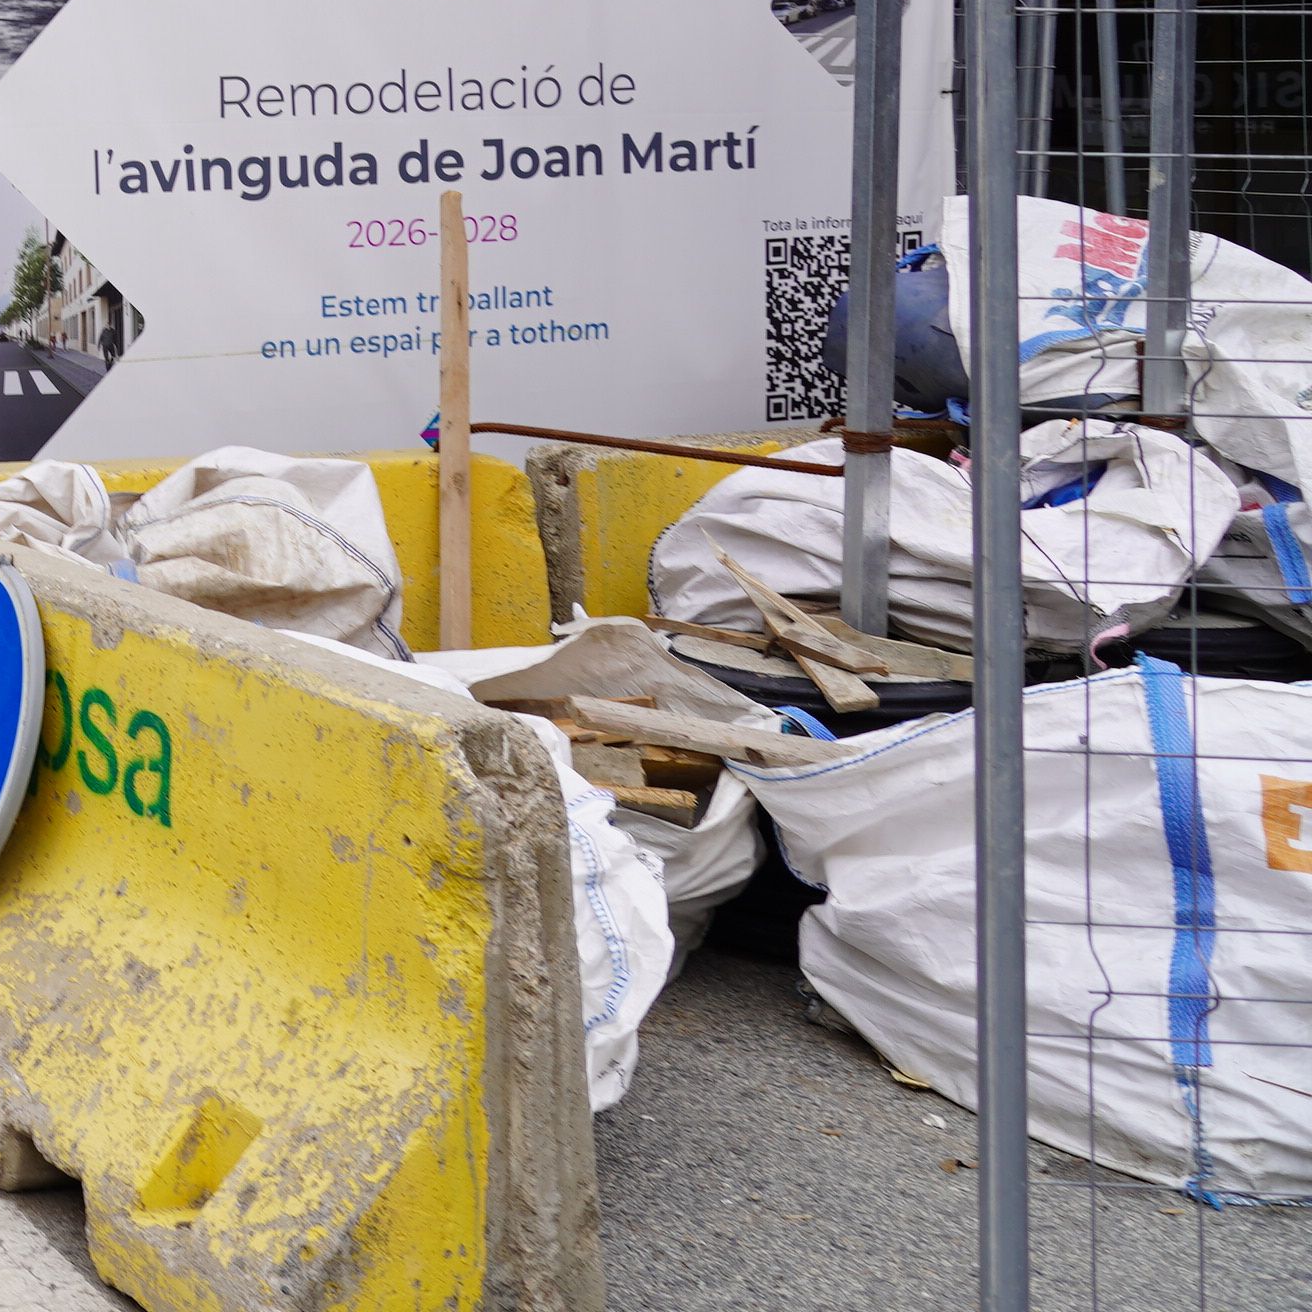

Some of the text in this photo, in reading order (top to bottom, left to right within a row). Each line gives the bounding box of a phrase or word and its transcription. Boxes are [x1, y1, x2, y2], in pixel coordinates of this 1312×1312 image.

[217, 61, 638, 120] Remodelació de
[92, 123, 760, 202] l'avinguda de Joan Martí
[344, 213, 520, 250] 2026-028
[761, 219, 792, 233] Tota
[795, 217, 807, 231] la
[320, 284, 555, 320] Estem trallant
[259, 315, 610, 360] en un espai pr a tothom
